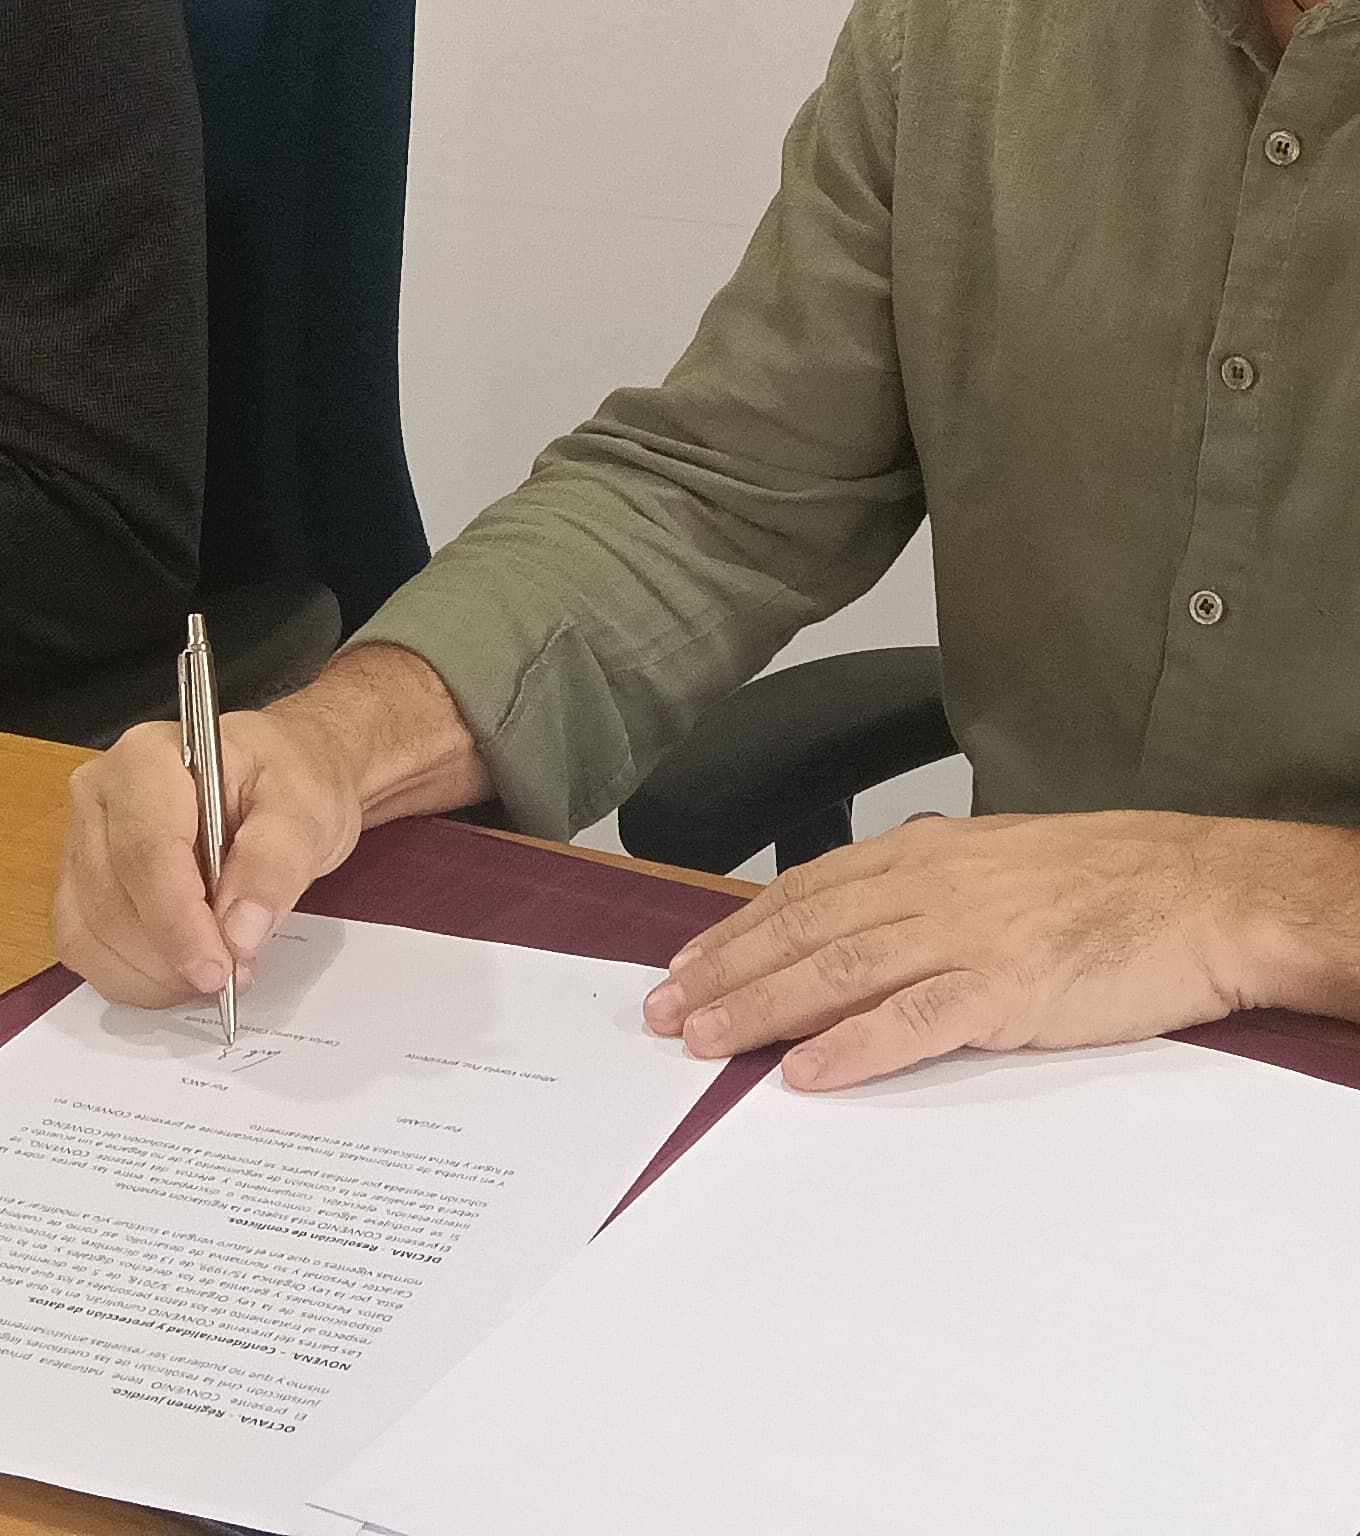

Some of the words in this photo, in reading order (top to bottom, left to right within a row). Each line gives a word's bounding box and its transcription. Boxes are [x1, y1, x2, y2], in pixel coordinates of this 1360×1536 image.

[291, 1228, 307, 1240] de
[310, 1232, 379, 1252] Resolución
[66, 1304, 83, 1315] de
[86, 1309, 155, 1329] protección
[168, 1325, 276, 1355] Confidencialidad
[166, 1399, 225, 1419] Régimen
